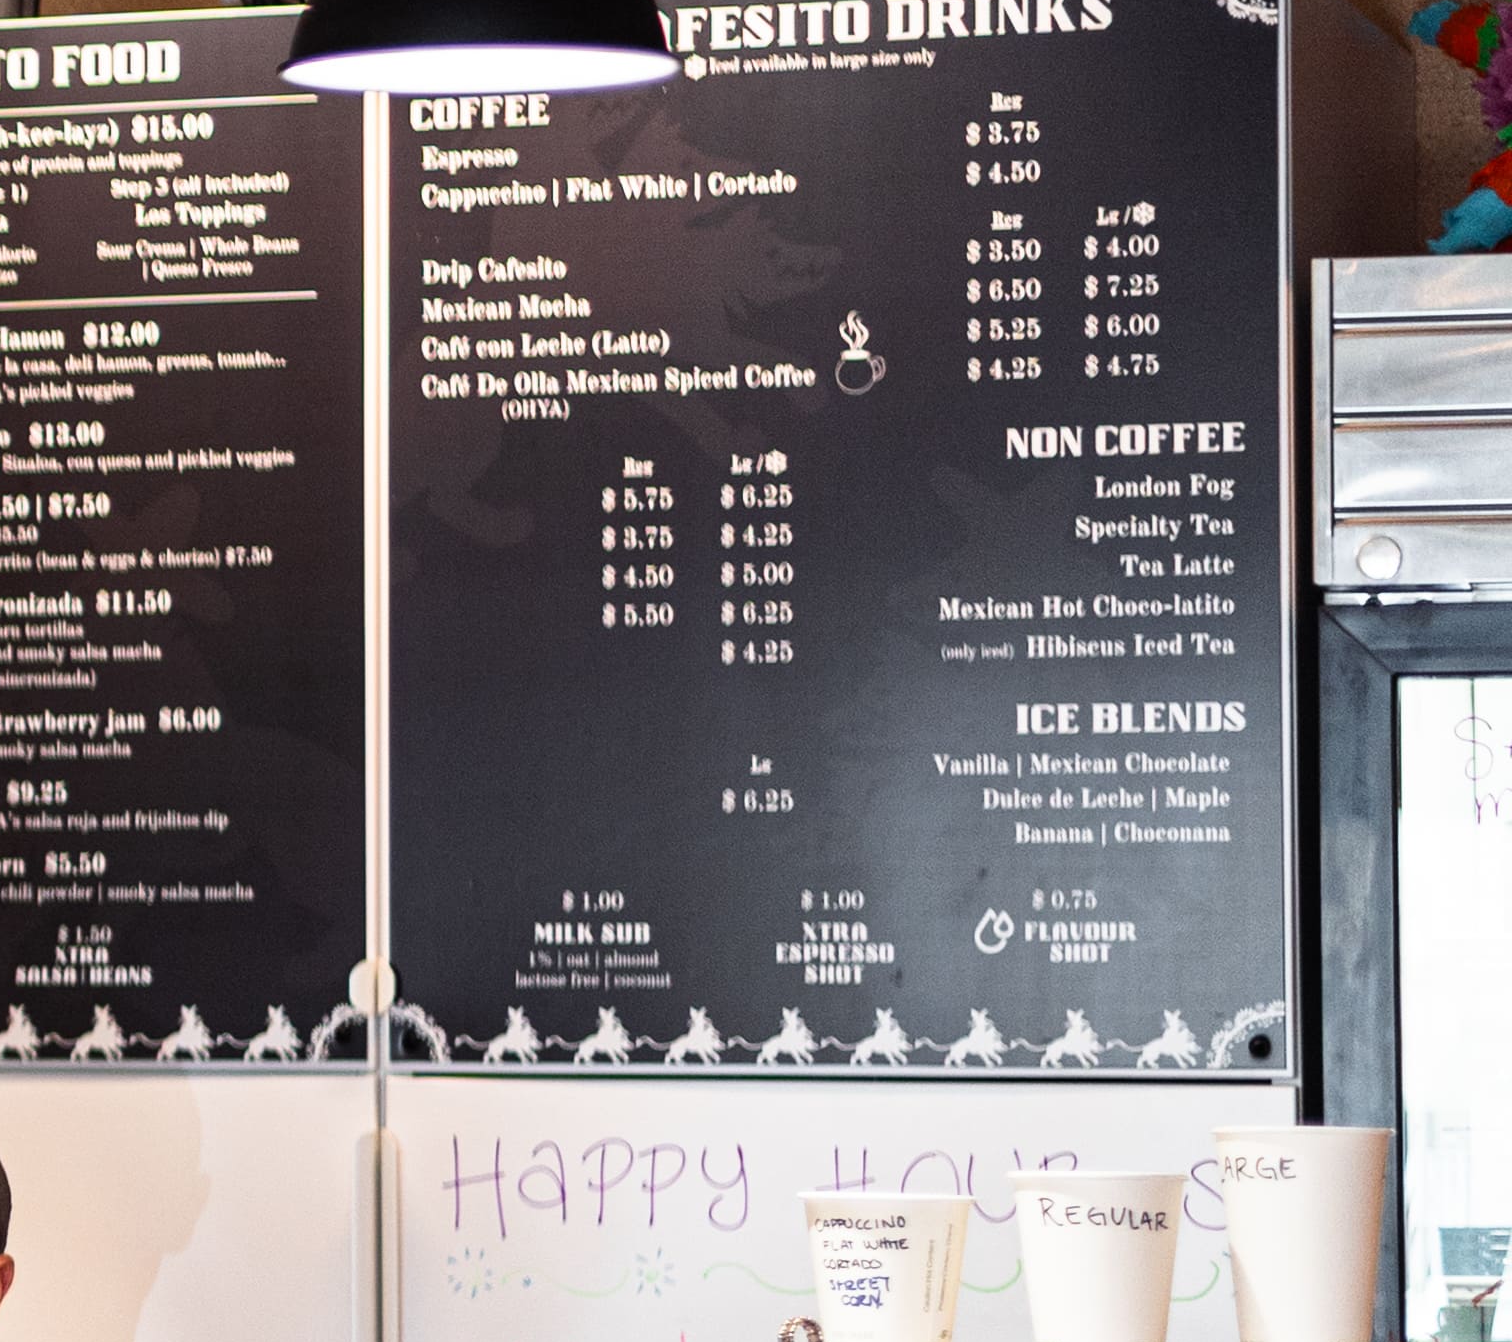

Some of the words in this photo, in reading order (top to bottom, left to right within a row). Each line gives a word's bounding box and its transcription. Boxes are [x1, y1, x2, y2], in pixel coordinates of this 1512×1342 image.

[52, 40, 180, 87] FOOD
[410, 94, 550, 132] COFFEE
[131, 113, 214, 143] $15.00
[422, 145, 518, 174] Espresso
[422, 181, 546, 211] Cappuccino
[567, 177, 613, 202] Flat
[619, 174, 687, 199] White
[708, 169, 796, 196] Cortado
[423, 297, 512, 322] Mexican
[519, 293, 591, 319] Mocha
[84, 321, 159, 348] $12.00
[29, 421, 104, 448] $13.00
[1007, 426, 1082, 458] NON
[1095, 421, 1245, 456] COFFEE
[1096, 475, 1180, 498] London
[1191, 473, 1234, 500] Fog
[1076, 515, 1181, 543] Specialty
[1190, 514, 1234, 535] Tea
[96, 590, 171, 615] $11.50
[940, 597, 1033, 620] Mexican
[1043, 596, 1085, 618] Hot
[1028, 635, 1125, 658] Hibiscus
[1135, 633, 1182, 656] Iced
[1191, 633, 1234, 655] Tea
[105, 708, 145, 737] jam
[159, 707, 221, 732] $6.00
[1017, 703, 1079, 734] ICE
[1093, 701, 1246, 734] BLENDS
[7, 781, 67, 804] $9.25
[1220, 1156, 1296, 1184] ARGE
[814, 1215, 906, 1232] CAPPUCCINO
[1038, 1198, 1168, 1231] REGULAR
